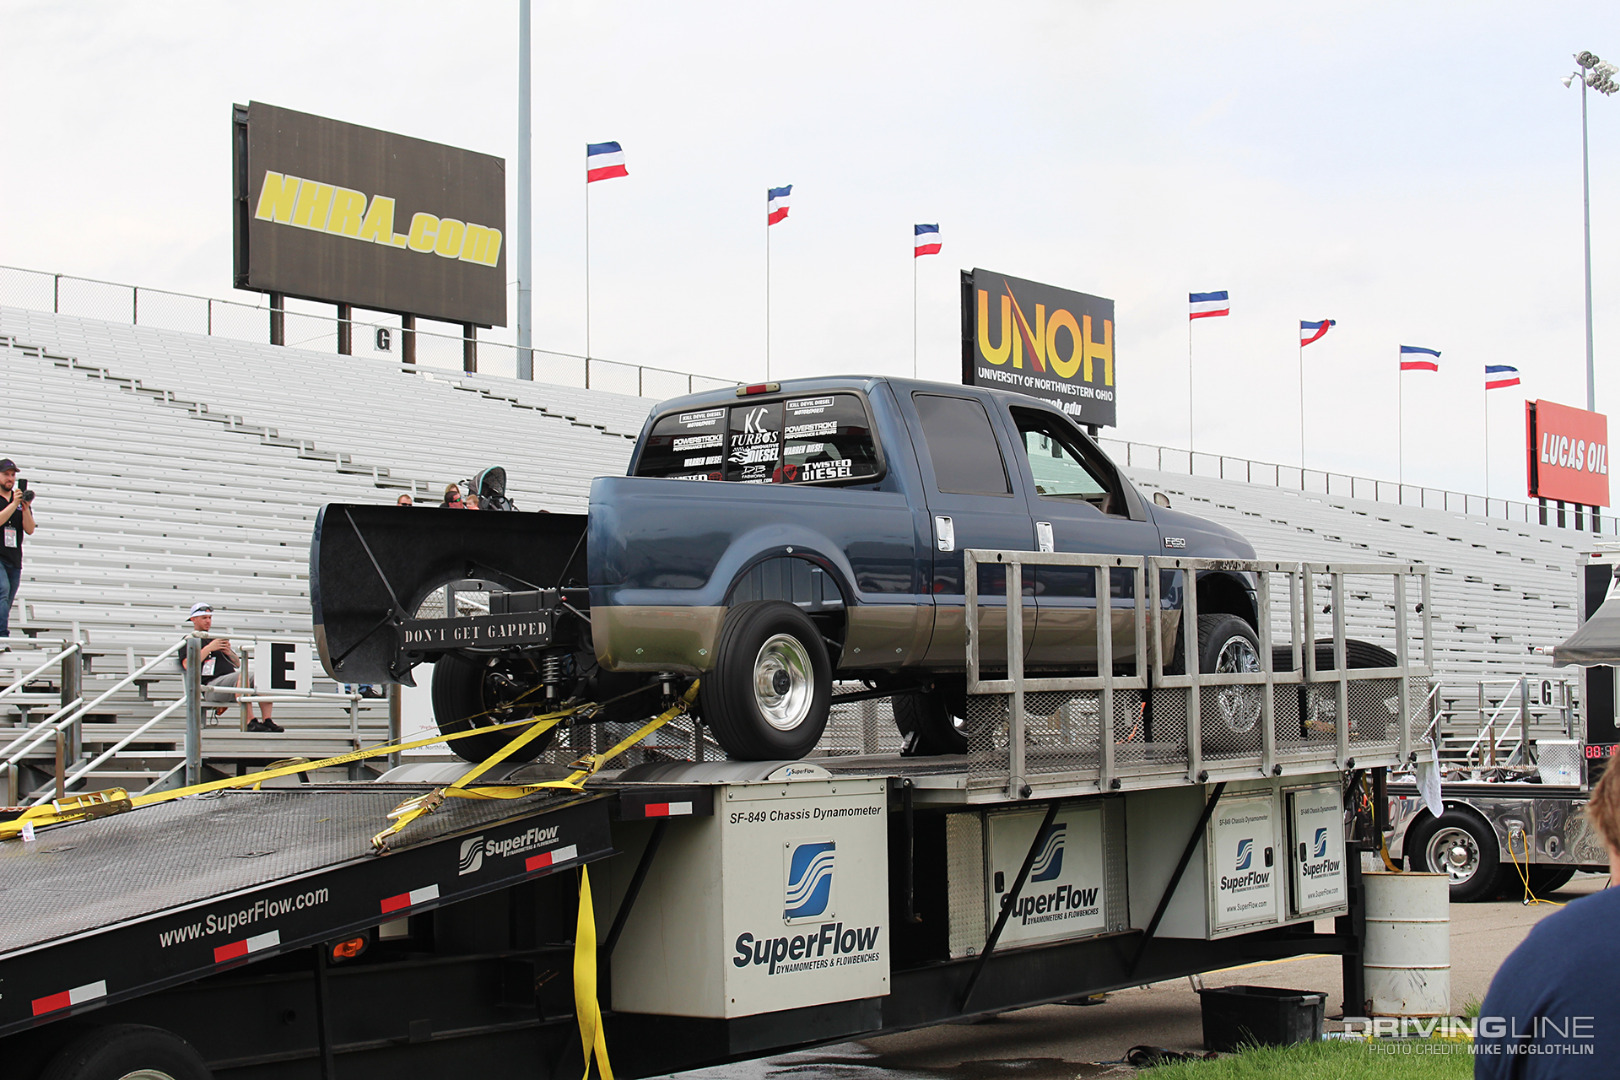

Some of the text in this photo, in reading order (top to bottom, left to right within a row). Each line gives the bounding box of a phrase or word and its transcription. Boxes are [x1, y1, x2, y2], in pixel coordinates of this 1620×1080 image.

[254, 170, 502, 268] NHRA.com
[376, 328, 391, 350] G
[977, 279, 1113, 386] UNOH
[978, 366, 1113, 402] UNIVERSITY OF NORTHWESTERN OHIO
[744, 407, 769, 434] KC
[784, 421, 838, 433] POWERSTROKE
[730, 431, 779, 447] TURBOS
[806, 443, 824, 453] DIESEL
[748, 448, 779, 462] DIESEL
[802, 459, 852, 471] TWISTED
[1540, 432, 1608, 475] LUCAS OIL
[802, 466, 853, 481] DIESEL
[404, 621, 547, 643] DON'T GET GAPPED
[270, 643, 296, 690] E
[1541, 680, 1552, 706] G
[729, 805, 881, 824] SF-849 Chassis Dynamometer
[485, 825, 559, 858] SuperFlow
[1302, 859, 1340, 880] SuperFlow
[1220, 871, 1270, 894] SuperFlow
[159, 887, 329, 948] www.SuperFlow.com
[1027, 912, 1063, 925] DYNAMOMETERS
[1068, 908, 1099, 920] FLOWBENCHES
[733, 922, 880, 976] SuperFlow
[776, 952, 880, 975] DYNAMOMETERS & FLOWBENCHES
